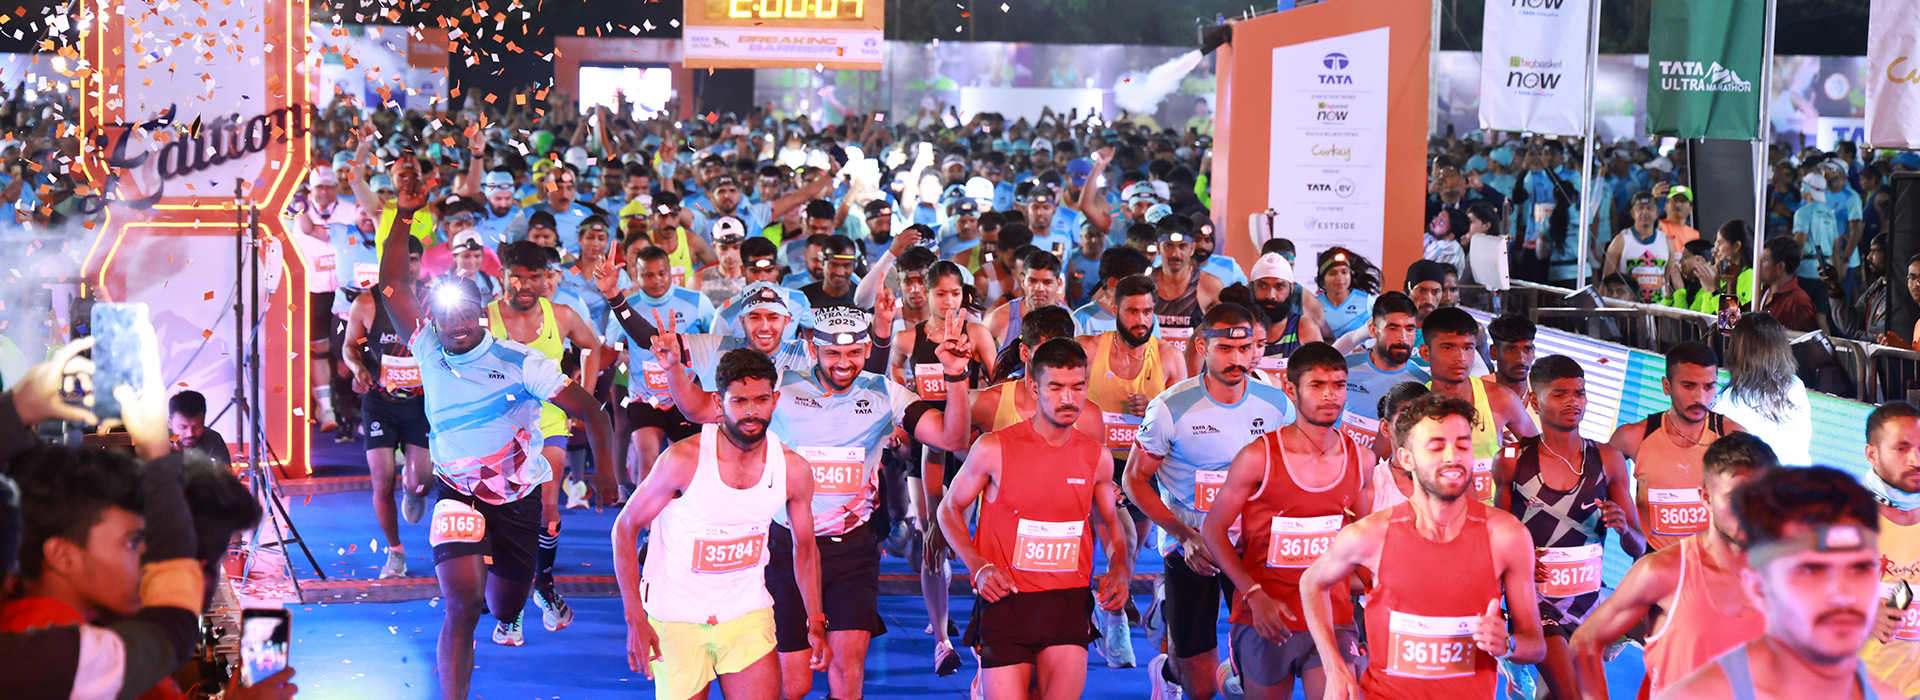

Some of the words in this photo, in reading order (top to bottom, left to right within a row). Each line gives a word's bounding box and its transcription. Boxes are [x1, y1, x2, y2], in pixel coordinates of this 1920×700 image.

[738, 35, 837, 45] BREAKING
[1659, 61, 1704, 76] TATA
[1318, 74, 1353, 84] TATA
[1506, 71, 1562, 89] now
[1661, 77, 1705, 91] ULTRA
[1706, 83, 1751, 92] MARATHON
[1316, 110, 1348, 121] now
[1307, 183, 1332, 192] TATA
[828, 318, 856, 327] 2025
[387, 368, 419, 381] 35352
[649, 373, 668, 385] 356
[924, 379, 945, 392] 381
[1109, 428, 1140, 441] 3588
[1660, 506, 1708, 525] 36032
[435, 516, 475, 535] 36165
[705, 539, 753, 562] 35784
[1025, 542, 1071, 560] 36117
[1280, 536, 1329, 556] 36163
[1550, 564, 1594, 586] 36172
[1402, 640, 1464, 664] 36152
